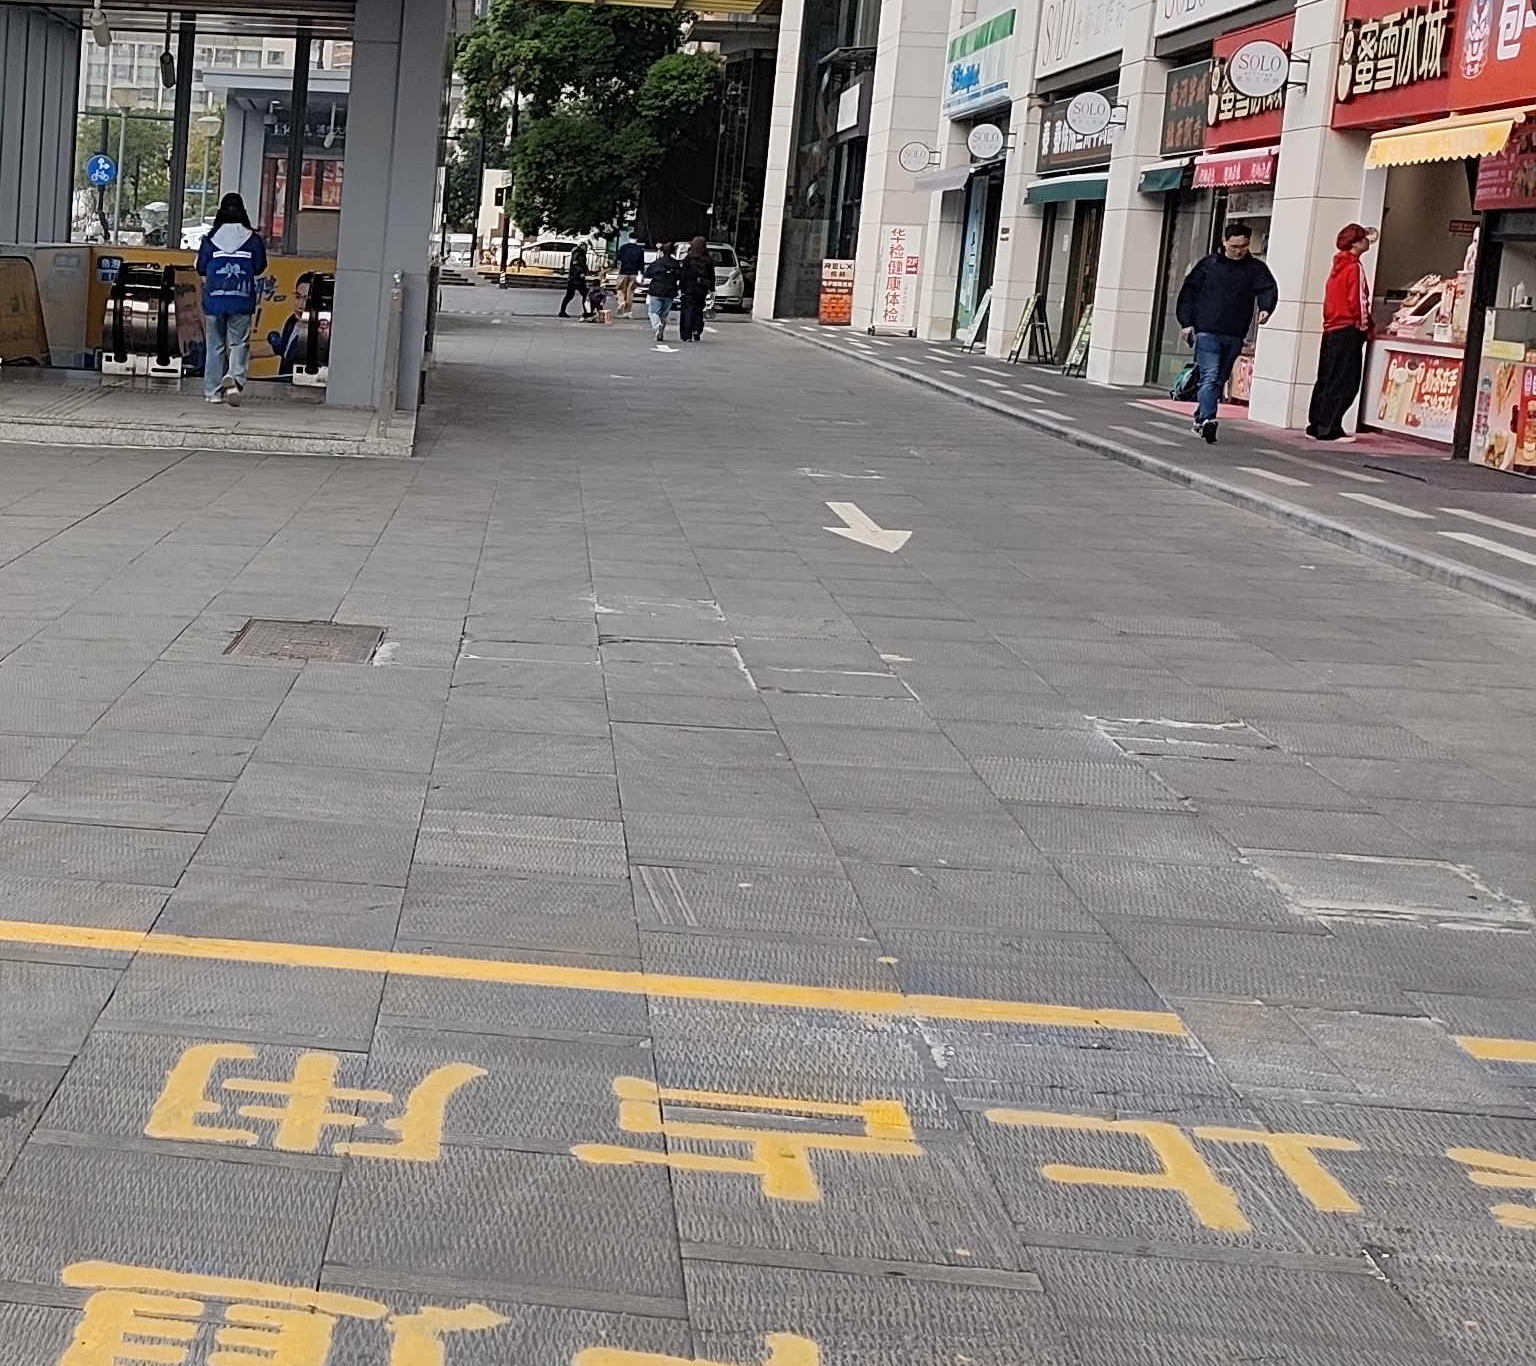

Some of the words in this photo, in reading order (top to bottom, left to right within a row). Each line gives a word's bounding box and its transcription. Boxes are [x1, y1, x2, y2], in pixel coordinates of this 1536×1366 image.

[1238, 53, 1282, 72] SOLO
[1072, 101, 1106, 116] SOLO
[972, 131, 999, 143] SOLO
[904, 149, 927, 159] SOLO
[823, 262, 853, 270] RELX
[882, 227, 907, 323] 华检健康体检
[144, 1041, 1536, 1234] 止占用
